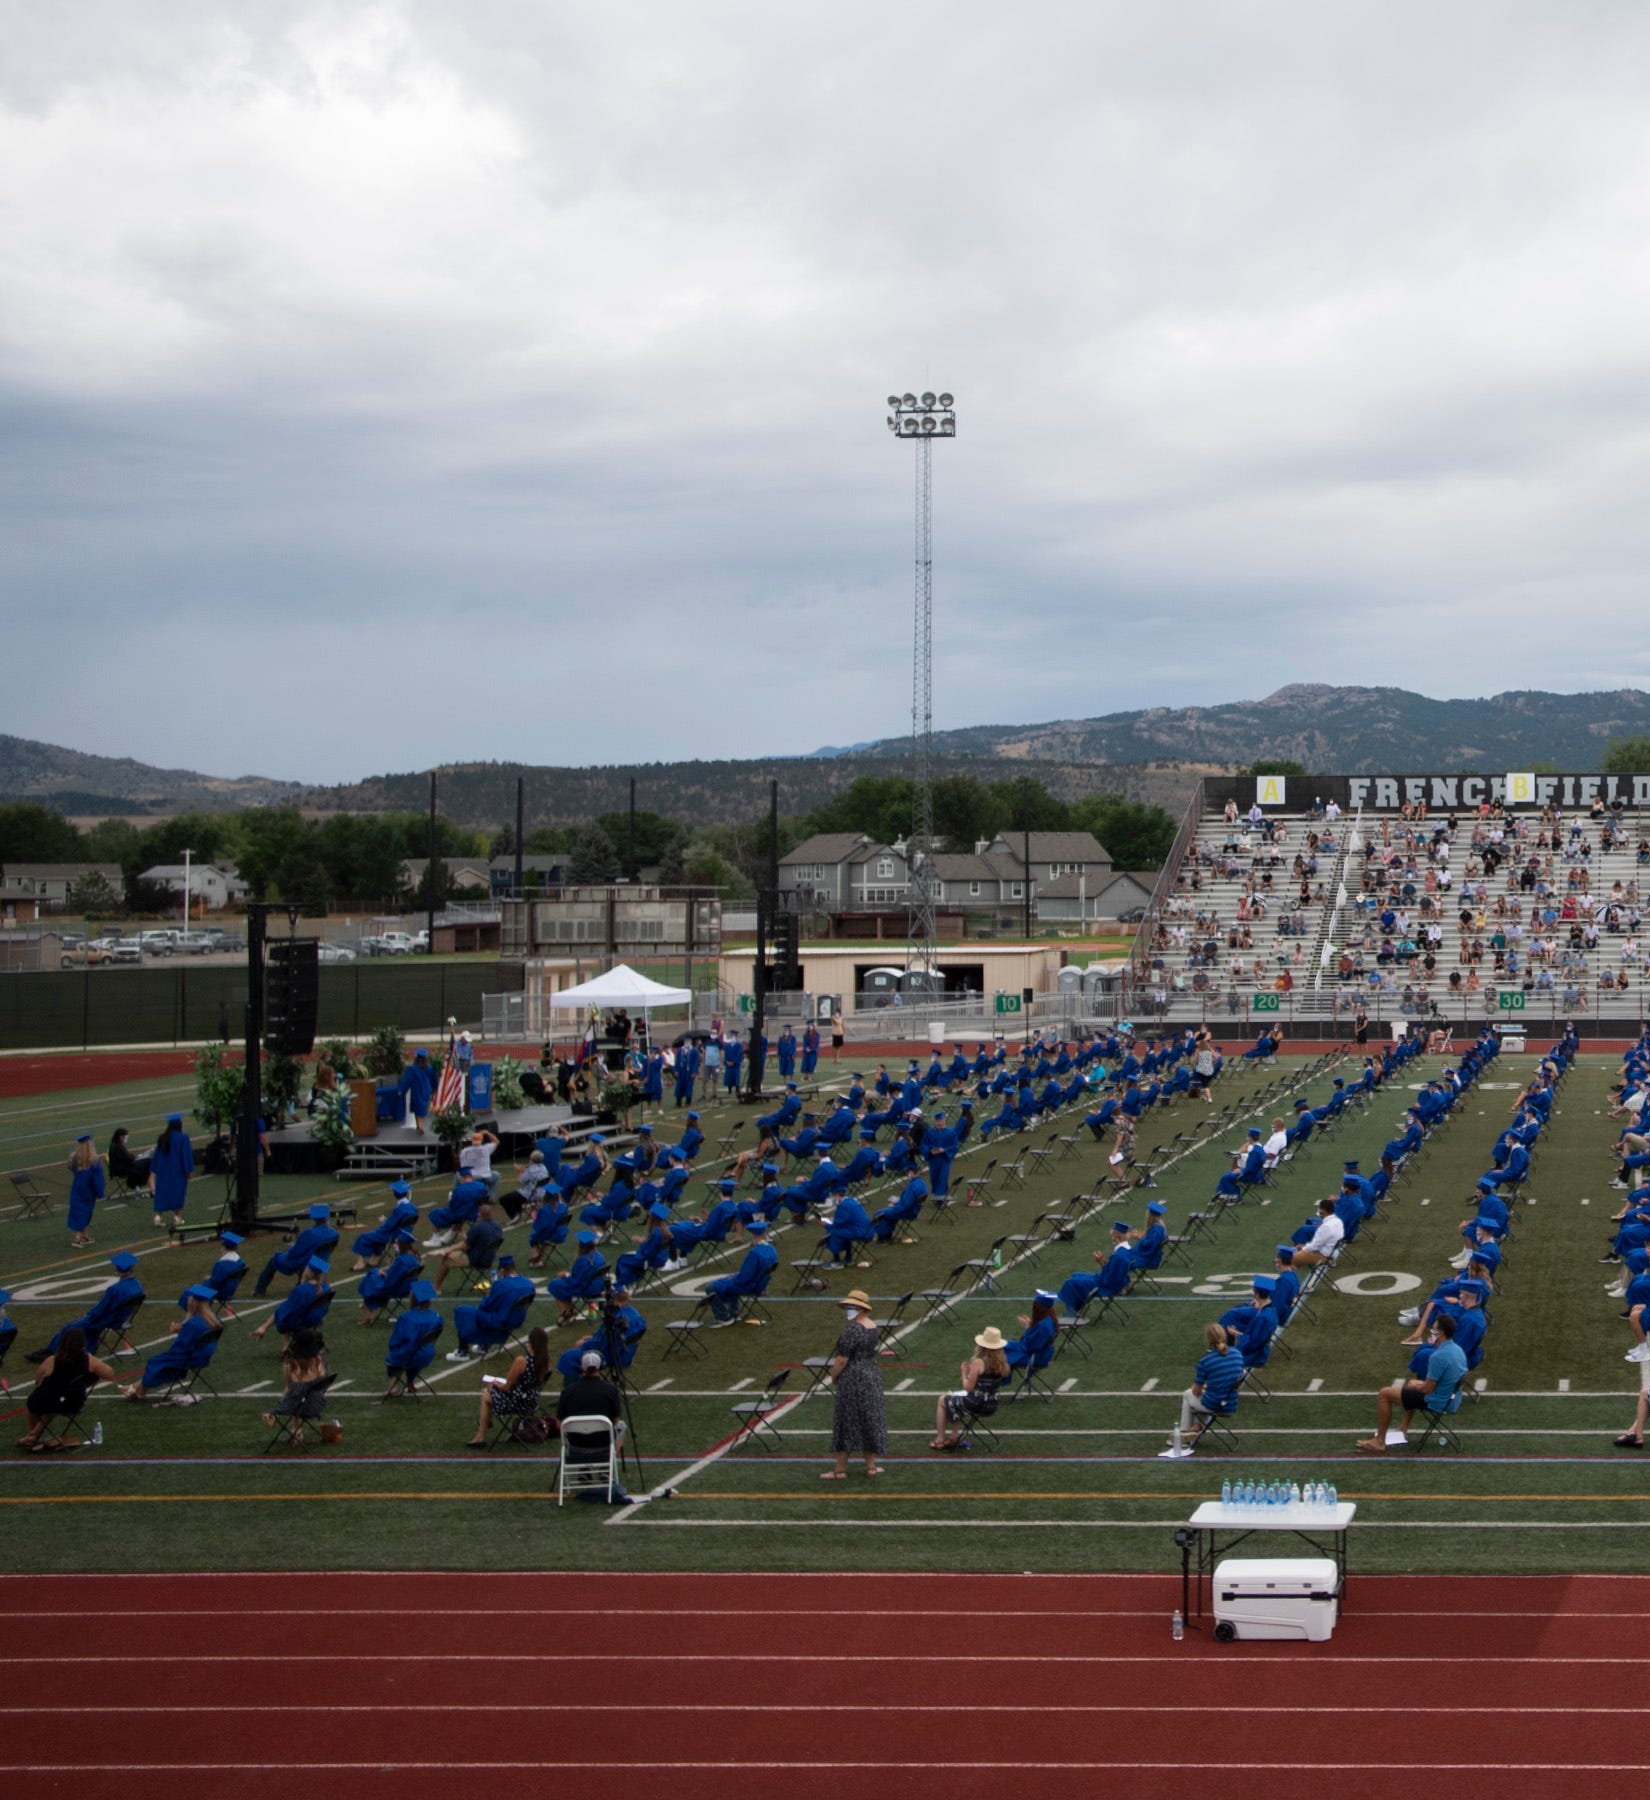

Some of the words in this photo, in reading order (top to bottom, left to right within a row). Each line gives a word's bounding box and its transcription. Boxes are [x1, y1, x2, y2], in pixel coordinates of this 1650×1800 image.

[1263, 777, 1279, 803] A
[1513, 775, 1528, 799] B
[1002, 996, 1016, 1011] 10
[1258, 995, 1277, 1009] 20
[1503, 994, 1522, 1008] 30
